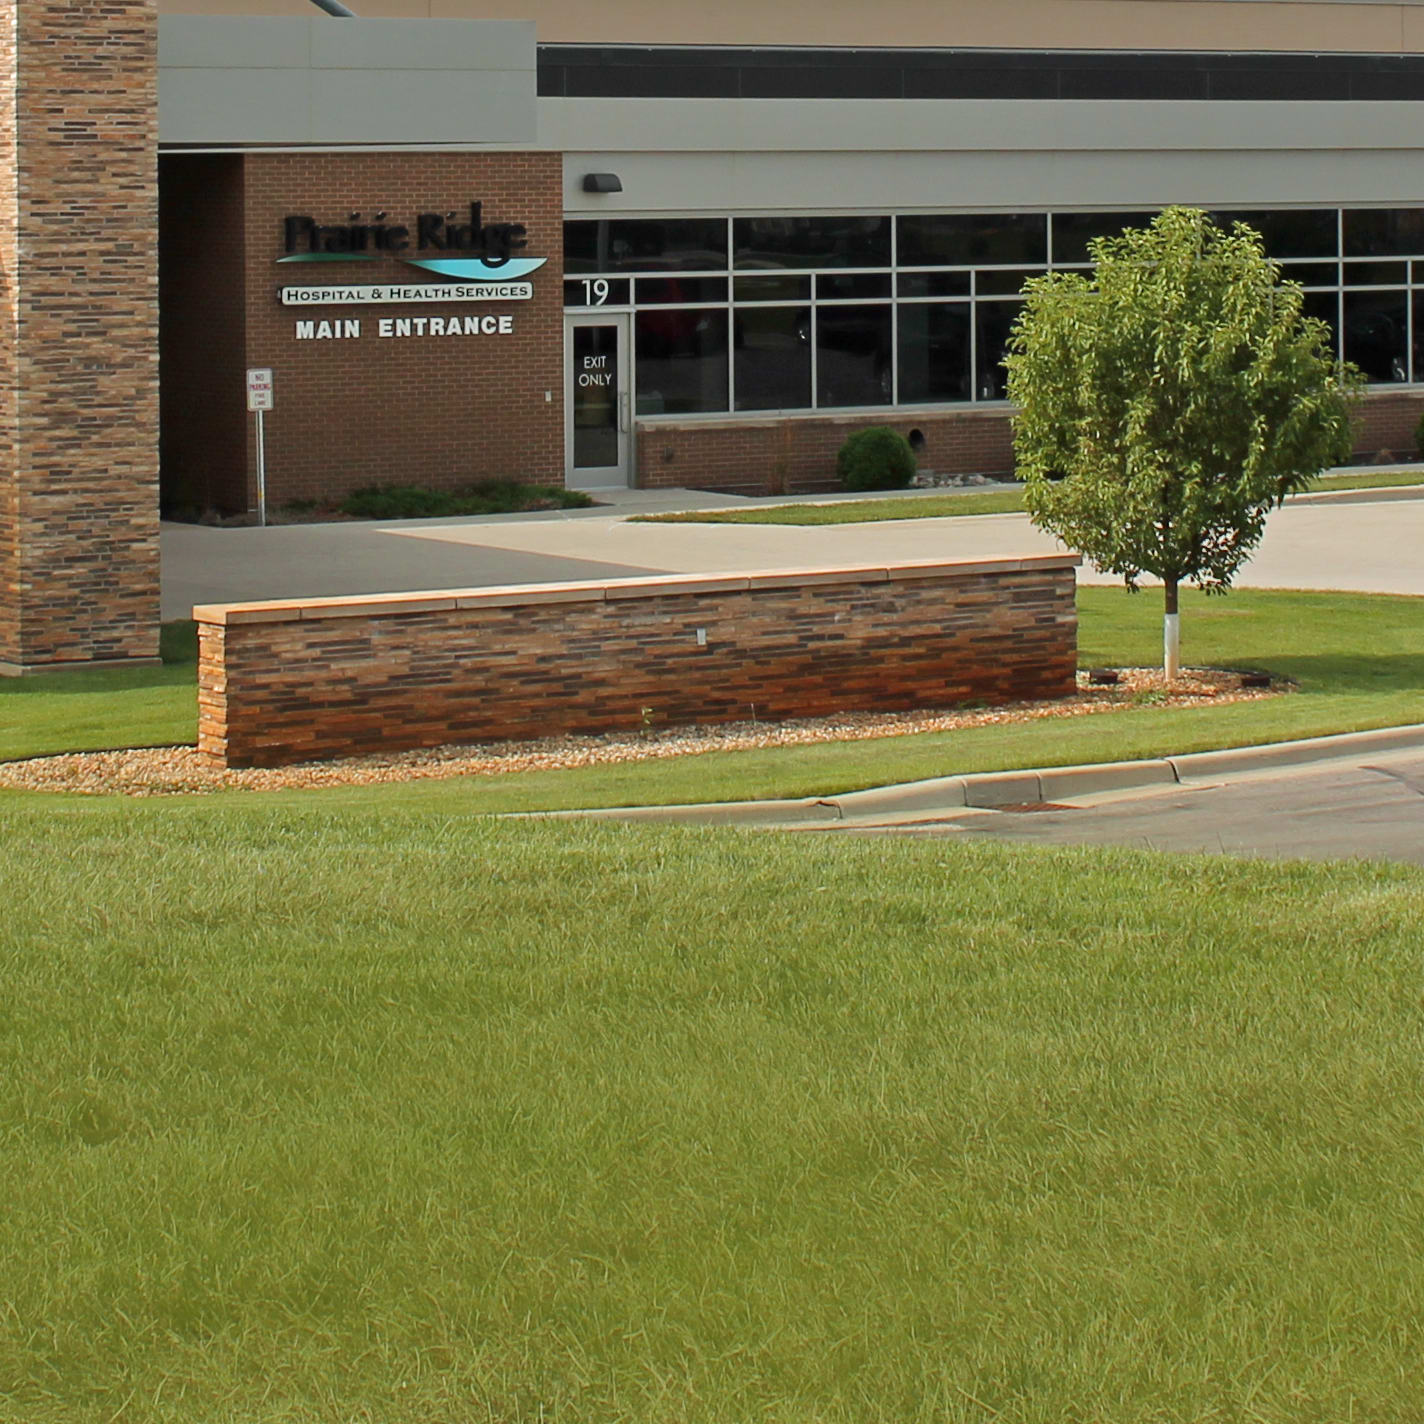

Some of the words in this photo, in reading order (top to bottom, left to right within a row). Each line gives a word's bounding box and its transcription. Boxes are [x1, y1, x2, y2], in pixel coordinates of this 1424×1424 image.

[284, 211, 410, 253] Prairie
[417, 201, 529, 269] Ridge
[286, 289, 365, 301] HOSPITAL
[371, 287, 383, 300] &
[389, 287, 451, 300] HEALTH
[455, 285, 528, 298] SERVICES
[581, 279, 609, 306] 19
[295, 319, 360, 340] MAIN
[378, 315, 514, 338] ENTRANCE
[583, 356, 607, 369] EXIT
[578, 373, 612, 387] ONLY
